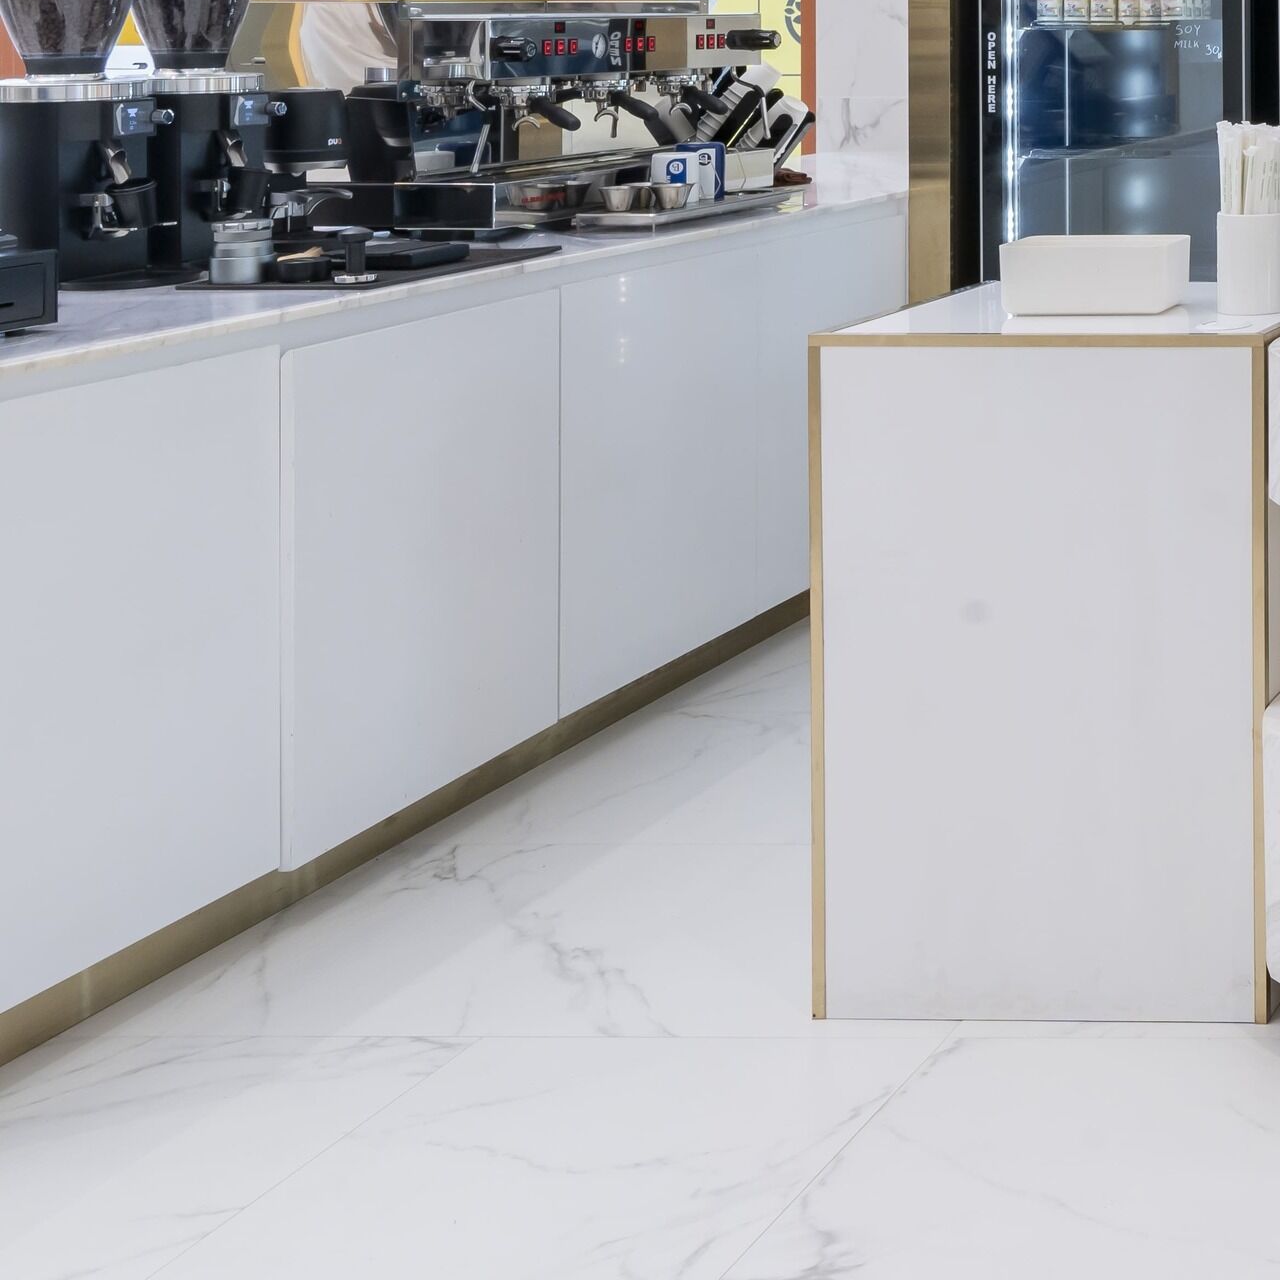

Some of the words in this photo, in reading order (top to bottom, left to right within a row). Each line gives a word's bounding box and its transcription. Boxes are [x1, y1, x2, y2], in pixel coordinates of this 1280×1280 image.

[1176, 25, 1200, 35] SOY
[987, 32, 996, 70] OPEN
[1174, 40, 1199, 48] MILK
[1206, 45, 1220, 55] 30
[988, 76, 996, 113] HERE
